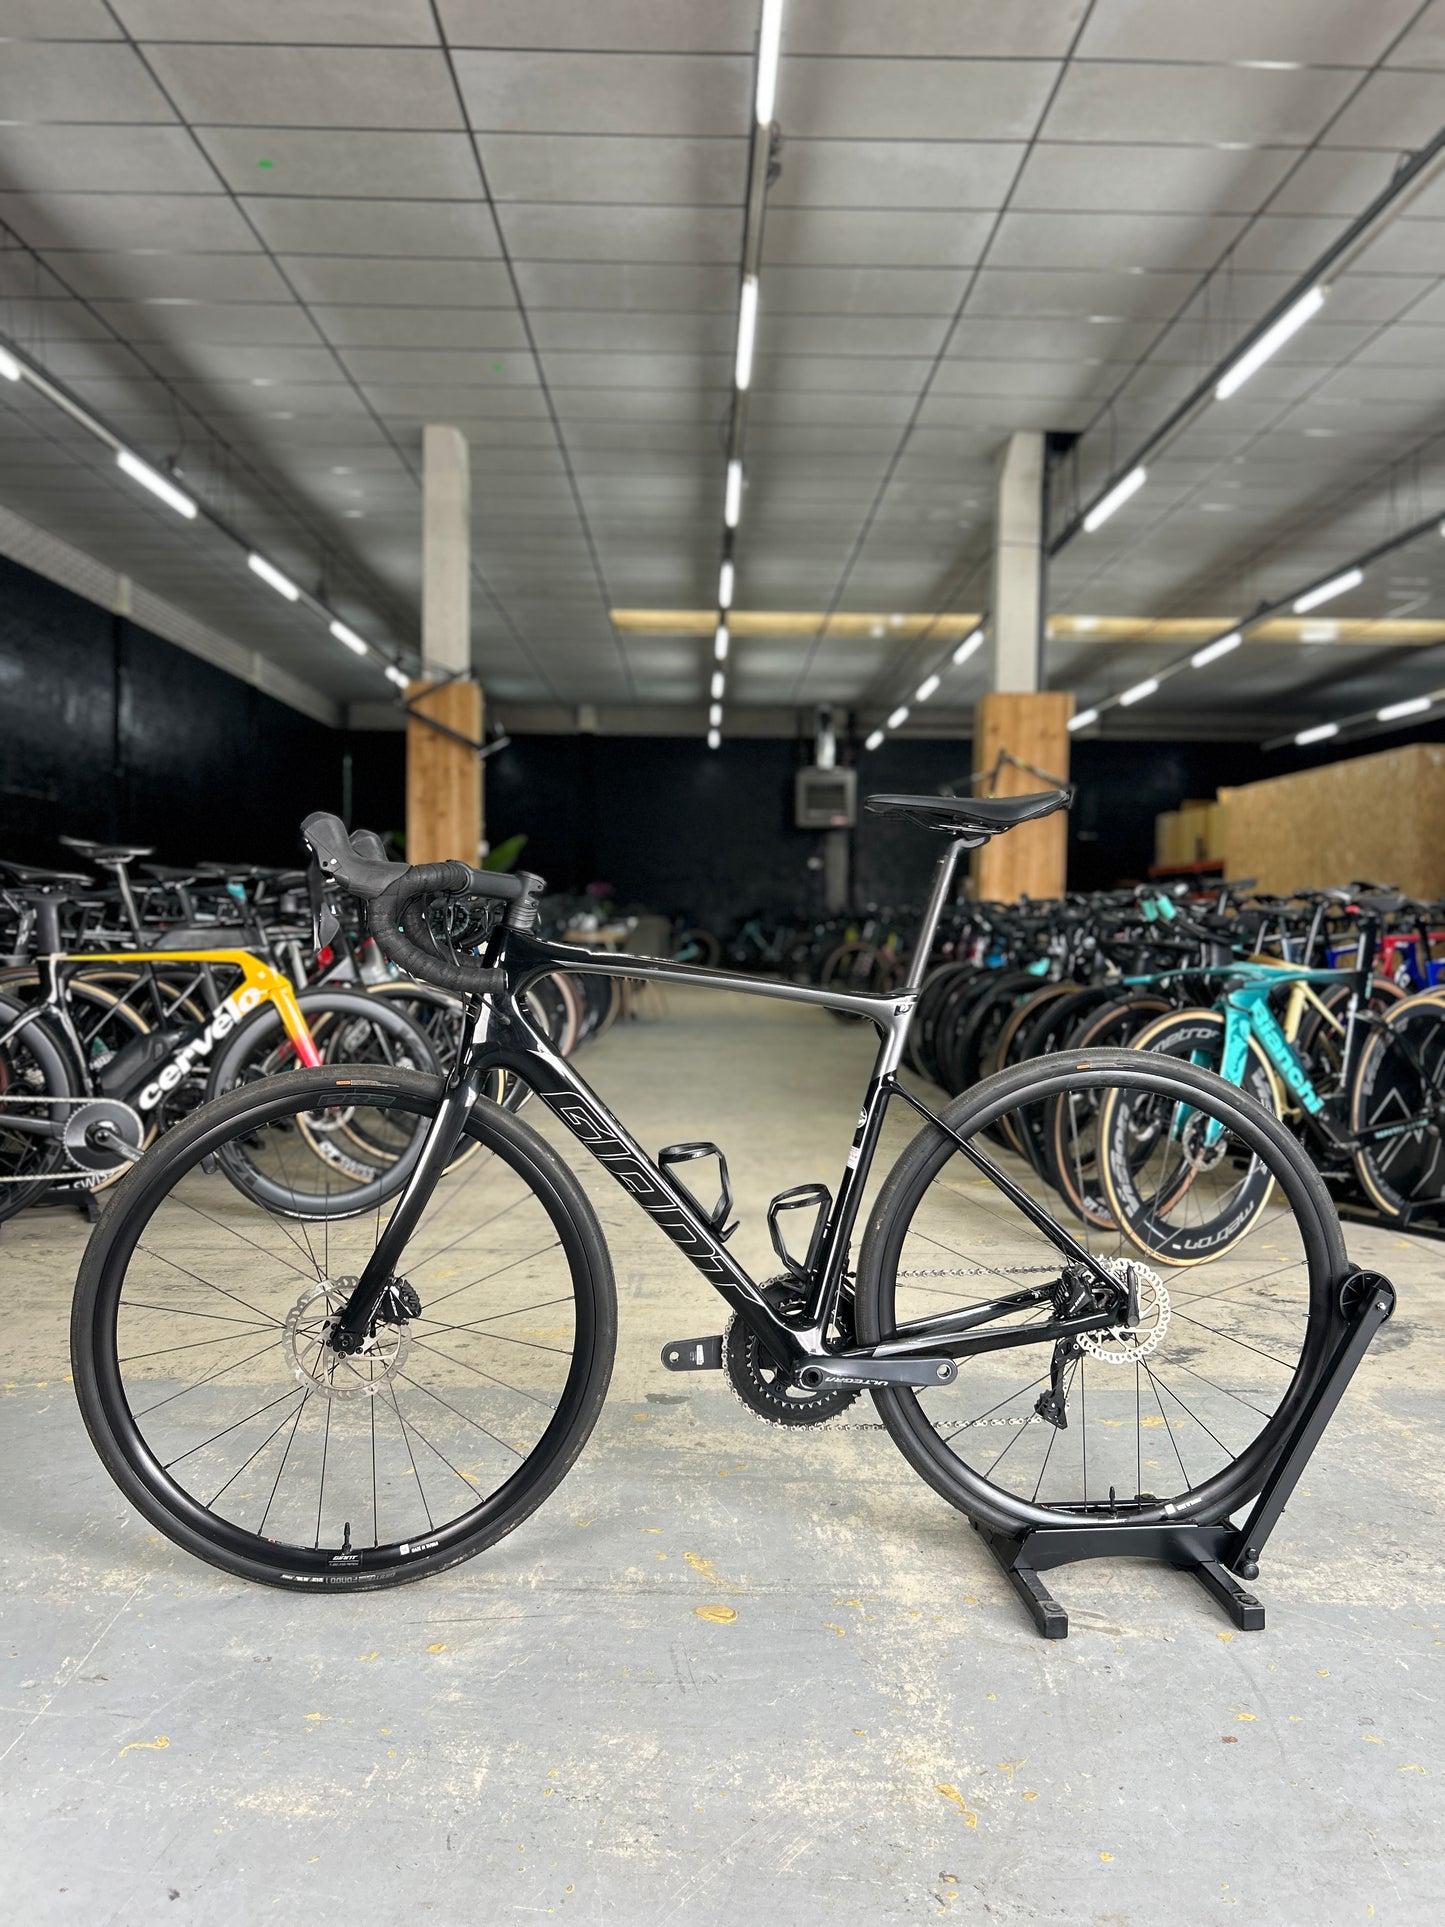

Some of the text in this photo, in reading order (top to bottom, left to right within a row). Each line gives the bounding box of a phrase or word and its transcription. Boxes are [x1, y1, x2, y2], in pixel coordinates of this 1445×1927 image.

[1250, 998, 1325, 1115] Bianchi
[540, 1090, 763, 1306] GIANT
[1183, 1200, 1255, 1250] metron
[824, 1376, 889, 1387] ULTEGRA
